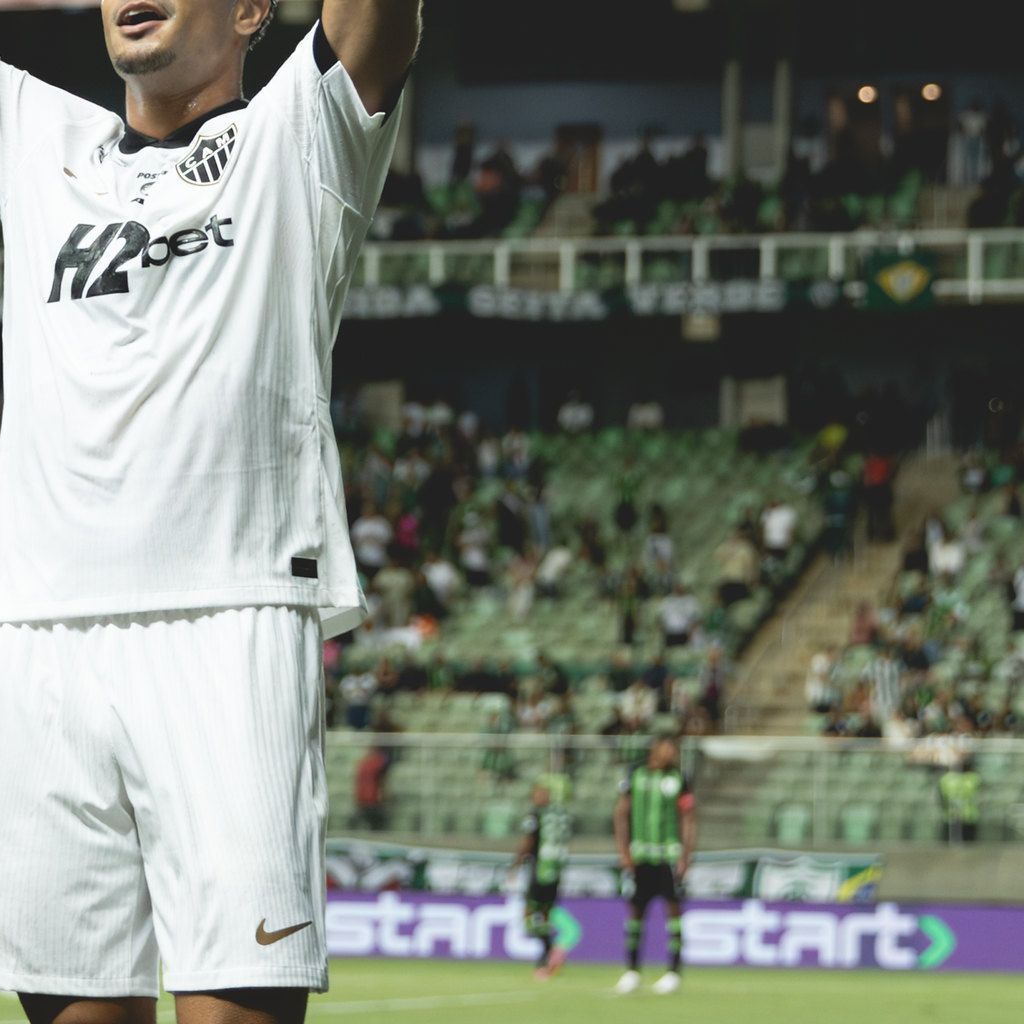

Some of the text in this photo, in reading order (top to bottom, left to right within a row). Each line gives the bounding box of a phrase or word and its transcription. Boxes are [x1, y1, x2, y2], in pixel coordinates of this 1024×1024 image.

[184, 132, 231, 170] CAM
[47, 214, 235, 303] H2bet
[323, 890, 544, 959] start
[681, 899, 918, 969] start
